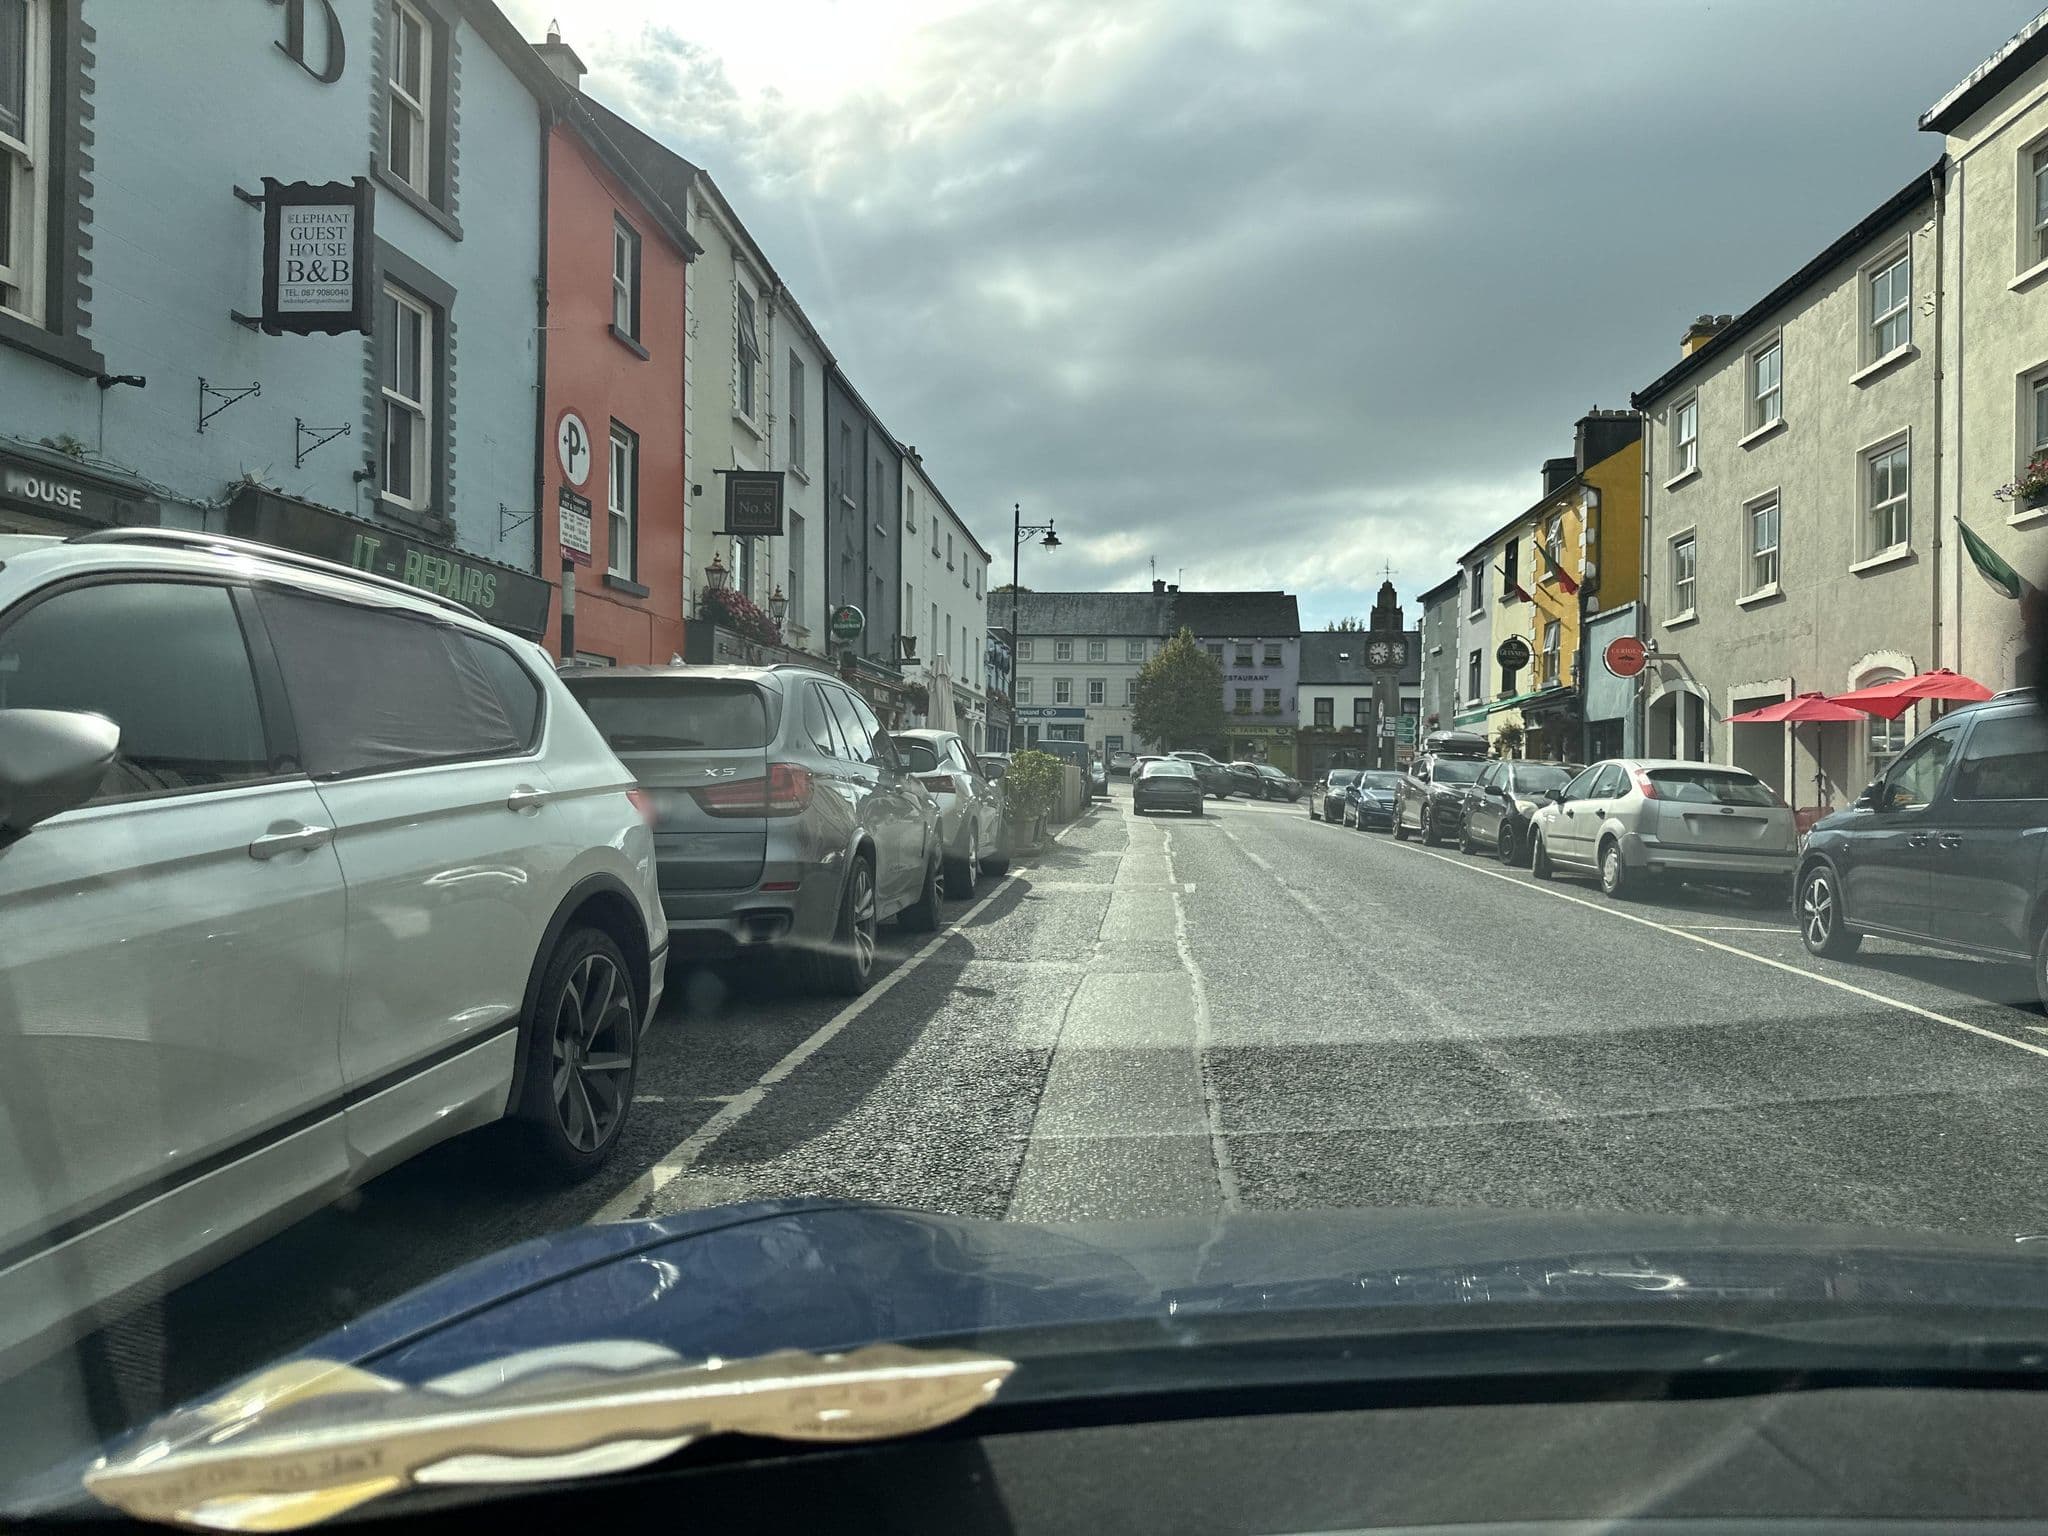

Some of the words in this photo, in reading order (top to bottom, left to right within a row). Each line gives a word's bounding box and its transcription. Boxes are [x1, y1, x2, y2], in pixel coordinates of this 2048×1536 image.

[287, 213, 349, 224] ELEPHANT
[290, 226, 347, 241] GUEST
[289, 243, 347, 257] HOUSE
[286, 259, 350, 283] B&B
[301, 288, 315, 297] 087
[568, 421, 580, 474] P
[351, 534, 381, 573] IT
[403, 549, 497, 609] REPAIRS
[1018, 709, 1040, 717] Ireland
[704, 767, 737, 777] X5
